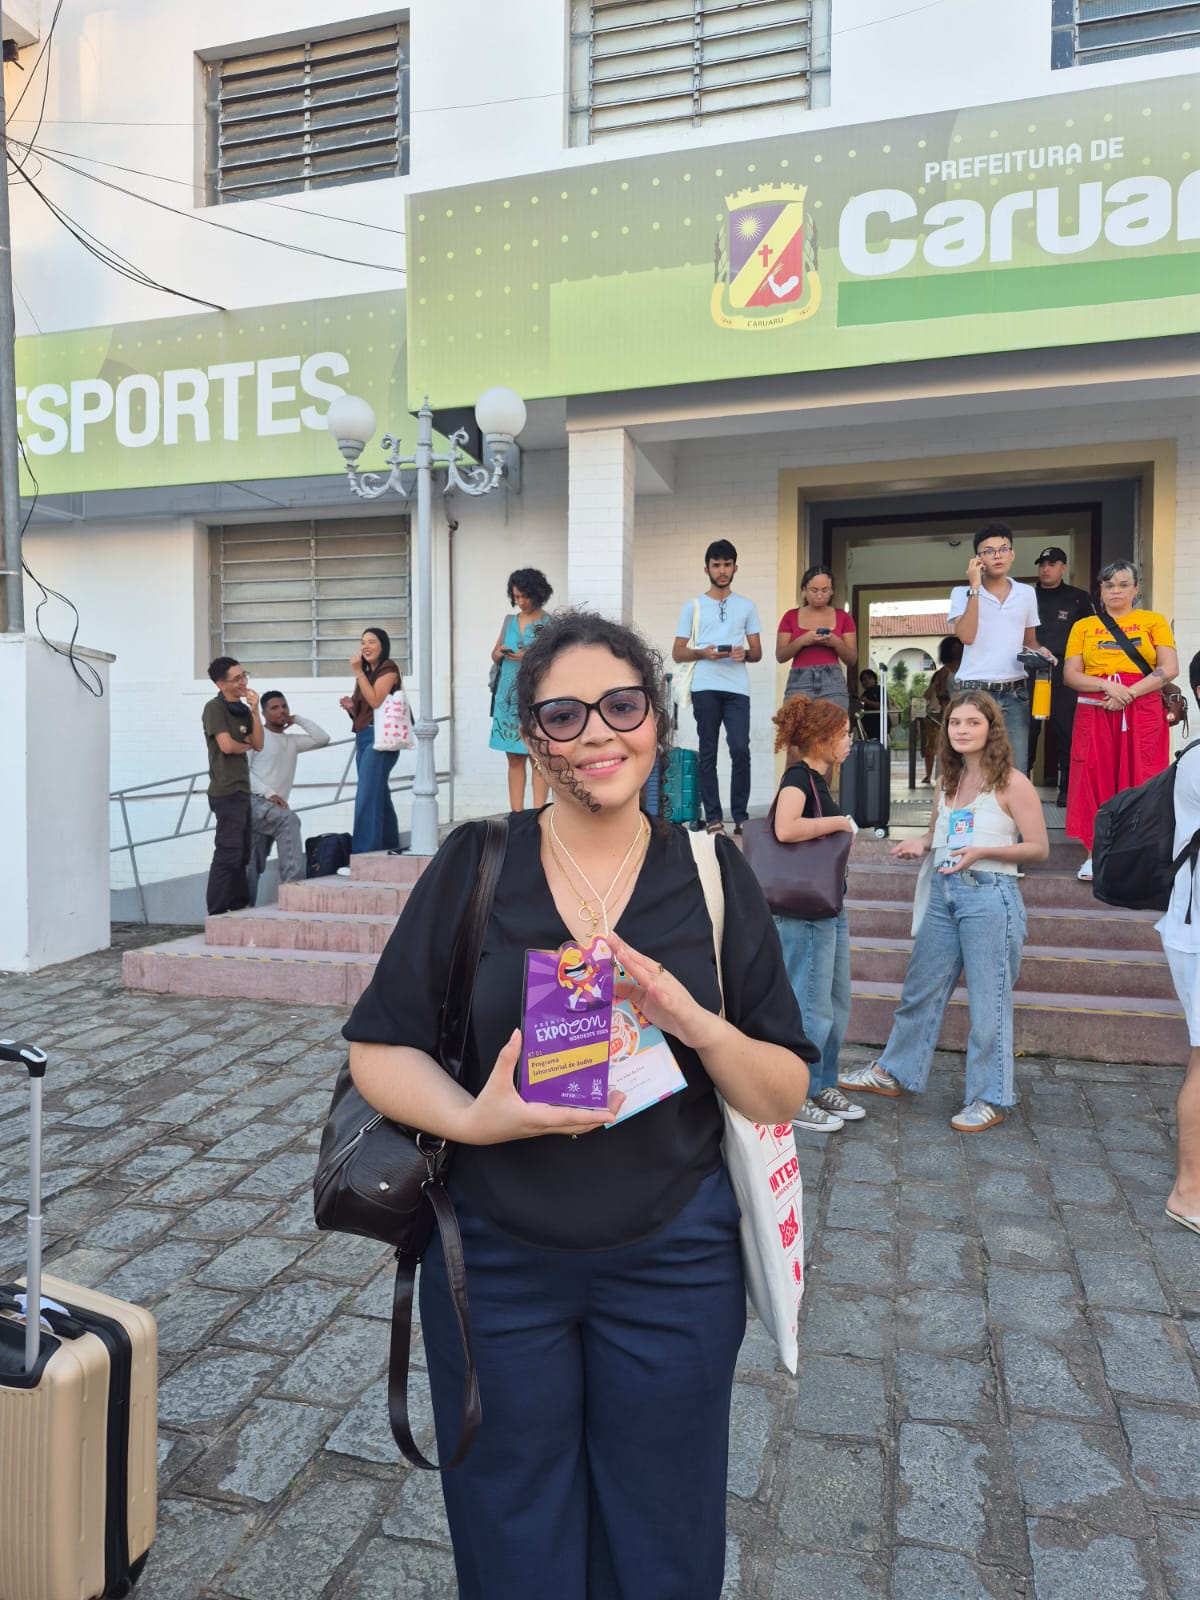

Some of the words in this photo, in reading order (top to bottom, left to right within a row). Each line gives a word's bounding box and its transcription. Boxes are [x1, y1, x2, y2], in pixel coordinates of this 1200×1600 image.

[925, 143, 1082, 183] PREFEITURA
[1090, 136, 1125, 162] DE
[747, 317, 784, 328] CARUARU
[15, 352, 350, 457] SPORTES
[531, 1057, 560, 1068] Programa
[532, 1063, 568, 1076] laboratorial
